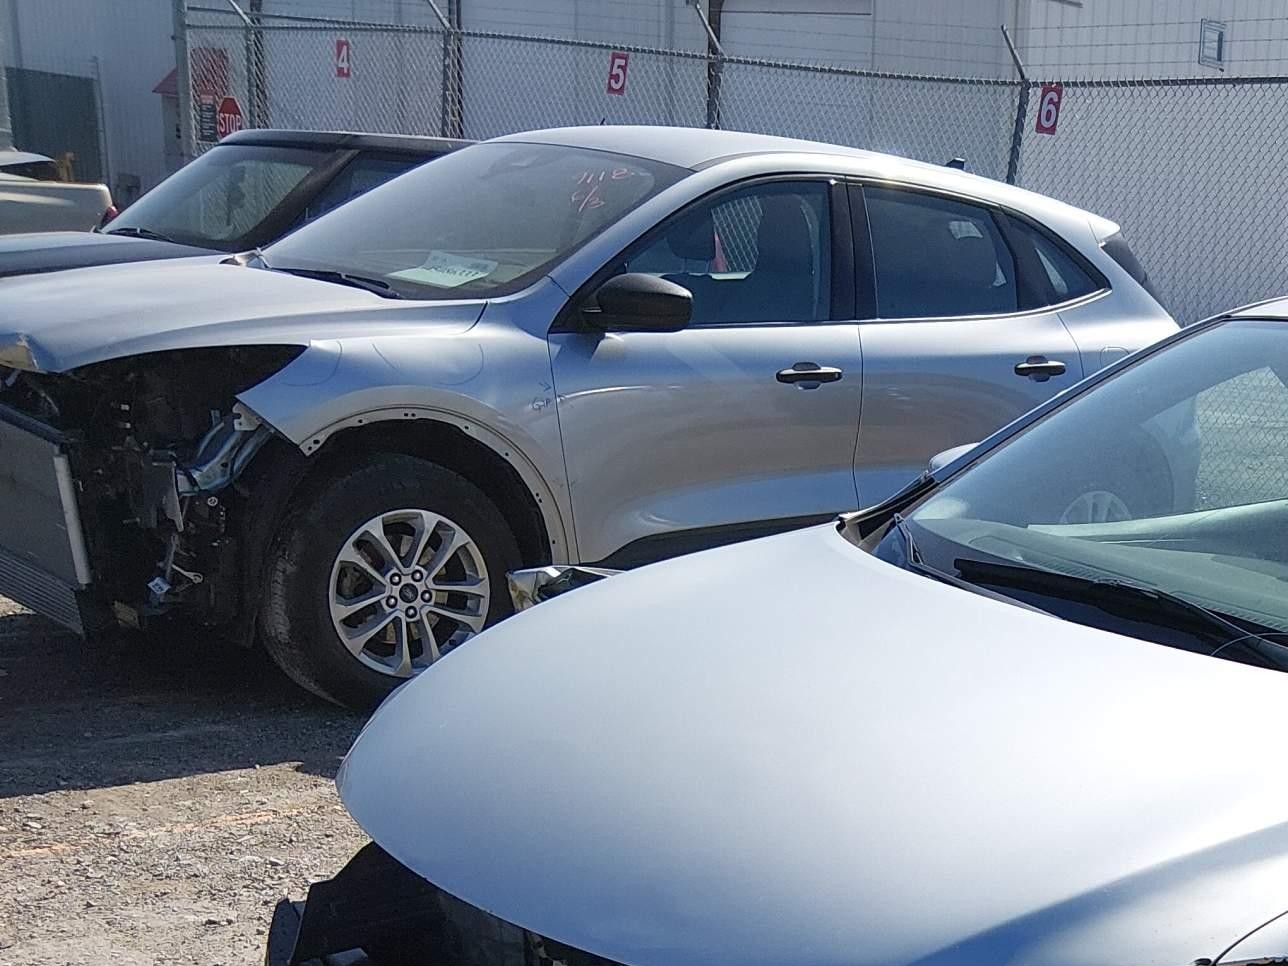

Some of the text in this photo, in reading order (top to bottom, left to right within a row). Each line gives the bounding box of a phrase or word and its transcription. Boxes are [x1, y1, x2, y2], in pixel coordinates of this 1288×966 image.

[338, 45, 350, 74] 4
[610, 58, 626, 90] 5
[219, 112, 242, 134] STOP
[1041, 91, 1059, 128] 6
